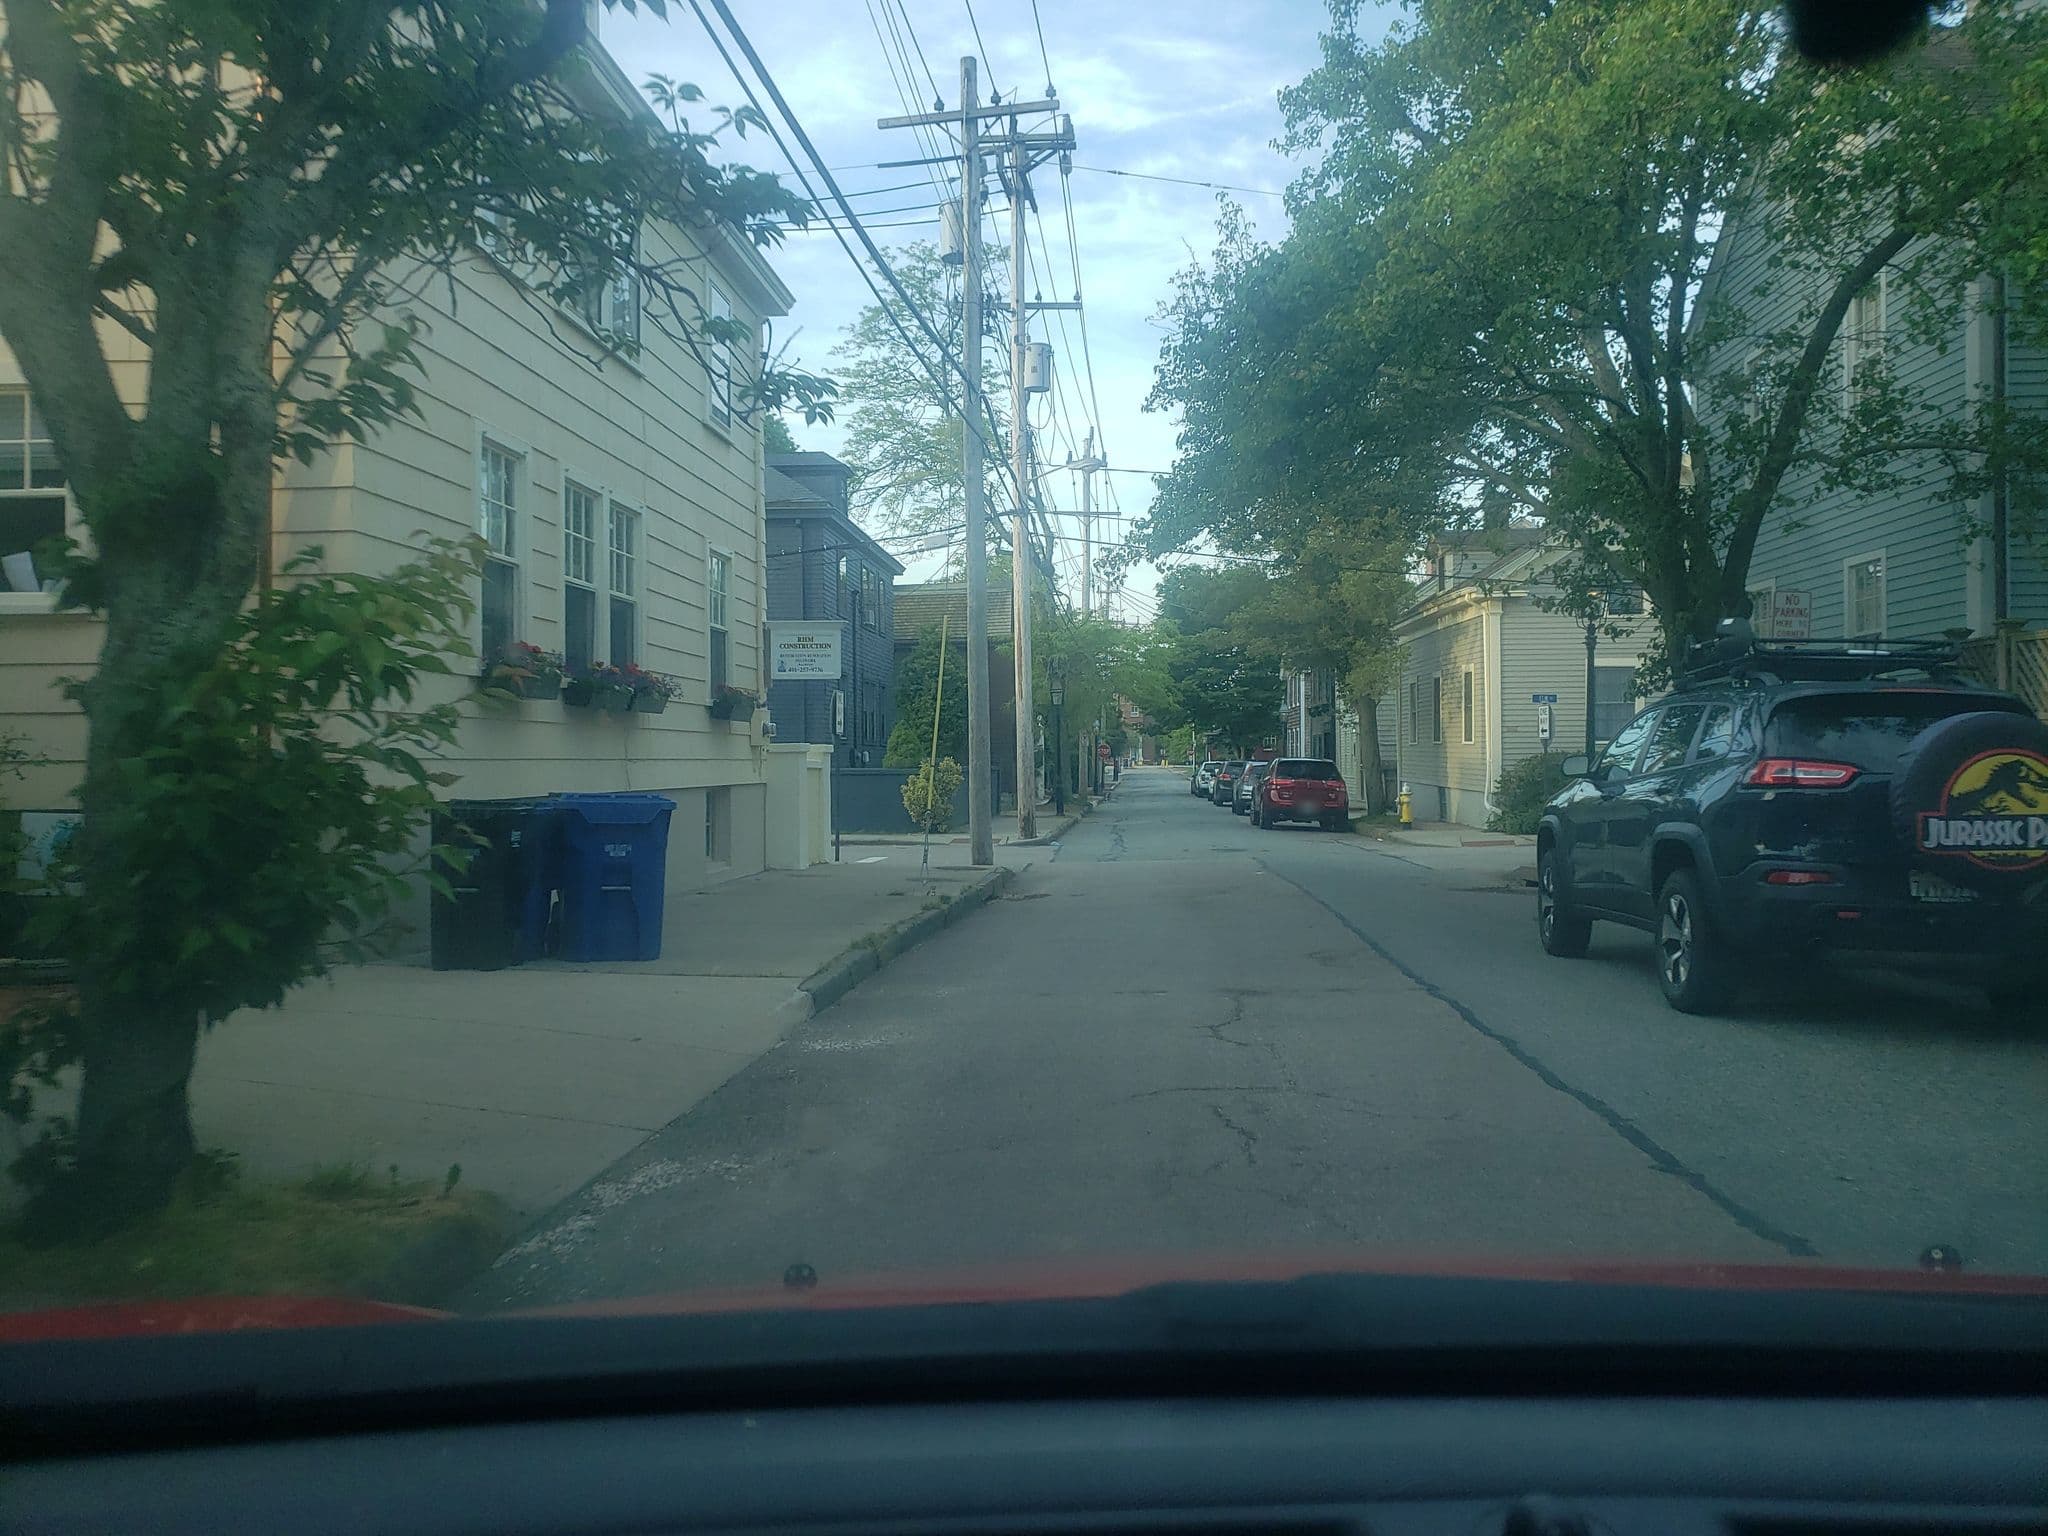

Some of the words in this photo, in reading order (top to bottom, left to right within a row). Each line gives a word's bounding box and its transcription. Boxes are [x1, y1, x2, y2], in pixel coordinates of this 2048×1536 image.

[1785, 594, 1800, 606] NO
[1775, 607, 1809, 618] PARKING
[1776, 619, 1793, 628] HERE
[1776, 630, 1806, 638] CORNER
[1923, 818, 2025, 849] JURASSIC
